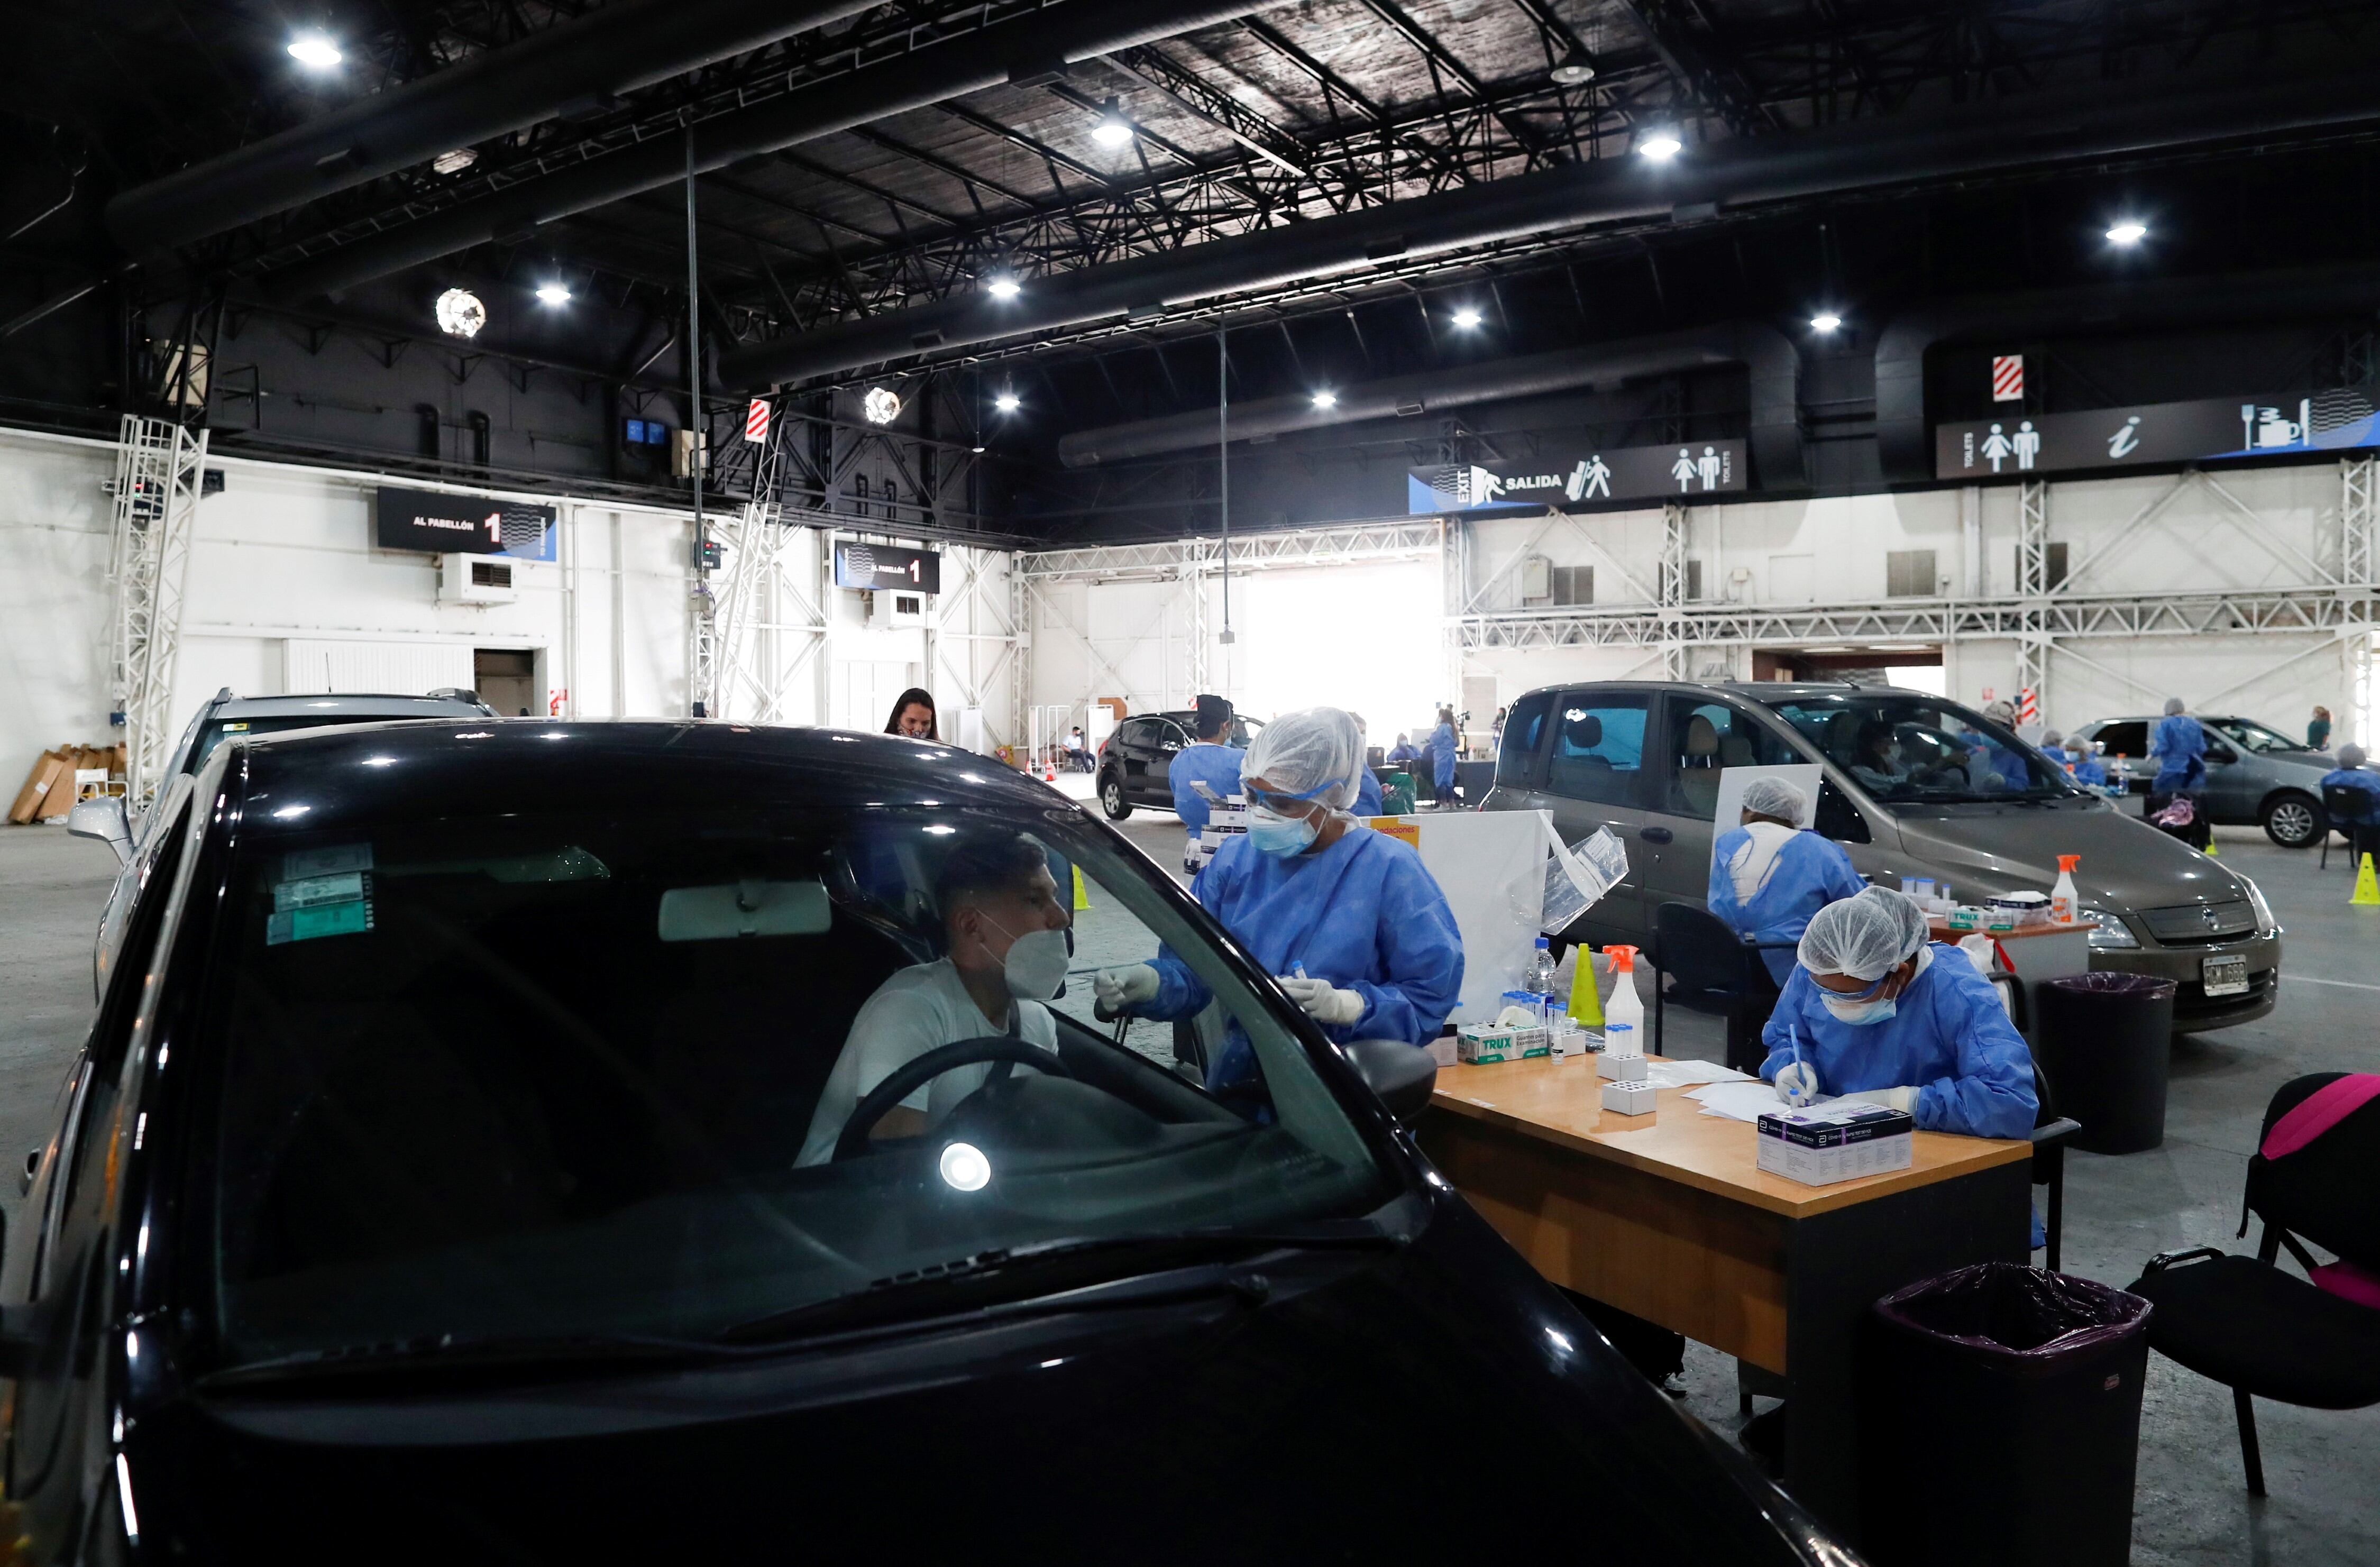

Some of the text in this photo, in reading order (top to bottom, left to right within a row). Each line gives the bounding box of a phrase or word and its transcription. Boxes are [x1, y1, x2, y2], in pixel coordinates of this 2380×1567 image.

[1964, 432, 1973, 469] TOILETS
[1457, 471, 1469, 502] EXIT
[1506, 474, 1562, 490] SALIDA
[414, 512, 500, 543] AL PABELLÓN 1
[878, 565, 905, 574] PABELLÓN
[909, 560, 920, 583] 1
[1483, 1037, 1511, 1050] TRUX
